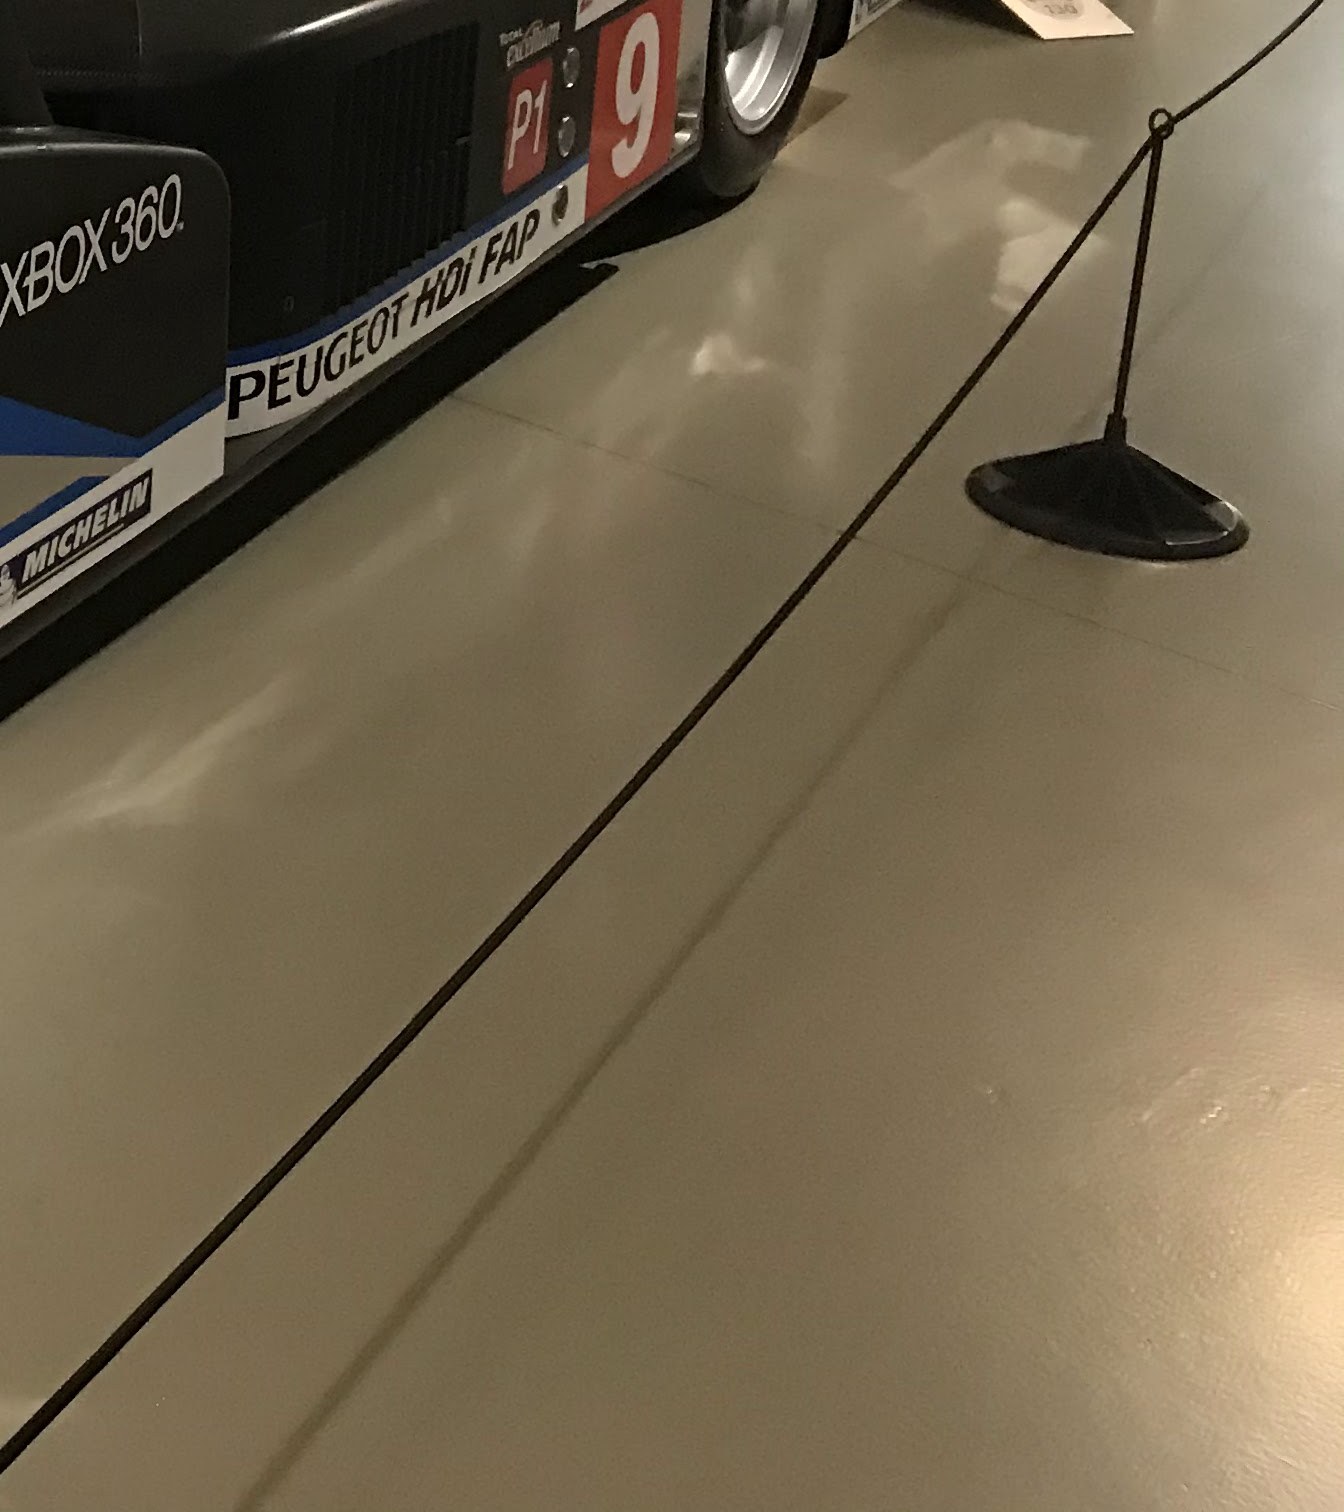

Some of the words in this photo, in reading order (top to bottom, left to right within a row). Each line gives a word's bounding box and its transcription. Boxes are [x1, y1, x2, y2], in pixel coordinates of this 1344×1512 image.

[508, 80, 547, 170] P1
[612, 13, 660, 178] 9
[111, 173, 183, 265] 360
[227, 292, 409, 421] PEUGEOT
[478, 208, 540, 284] FAP
[22, 477, 150, 583] MICHELIN
